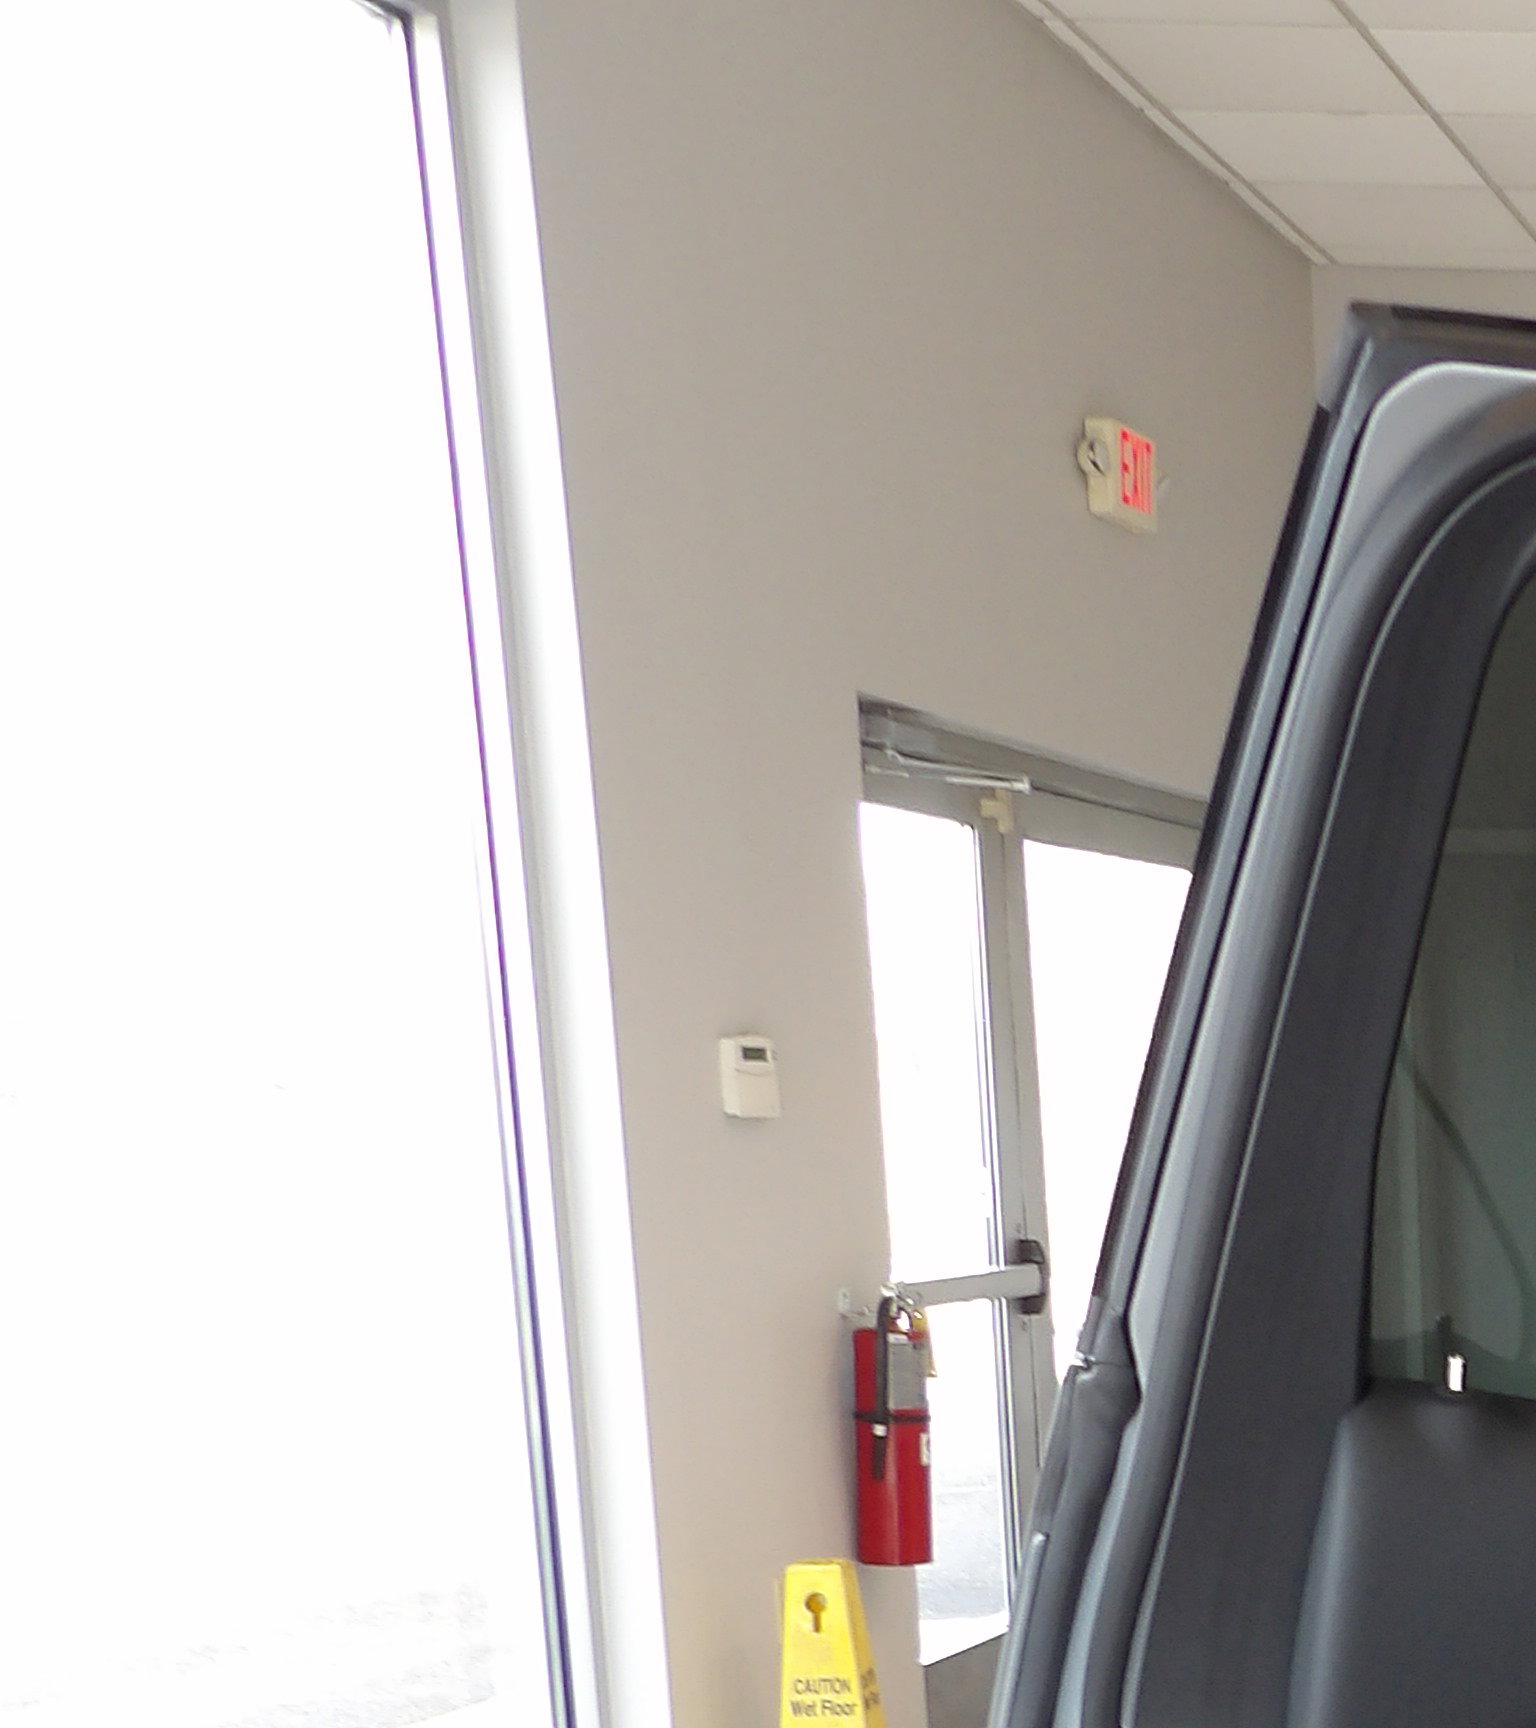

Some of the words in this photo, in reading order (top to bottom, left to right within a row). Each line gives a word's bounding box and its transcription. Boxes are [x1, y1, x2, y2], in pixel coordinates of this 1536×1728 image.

[794, 1678, 851, 1695] CAUTION
[790, 1700, 818, 1718] Wet
[821, 1699, 858, 1717] Floor
